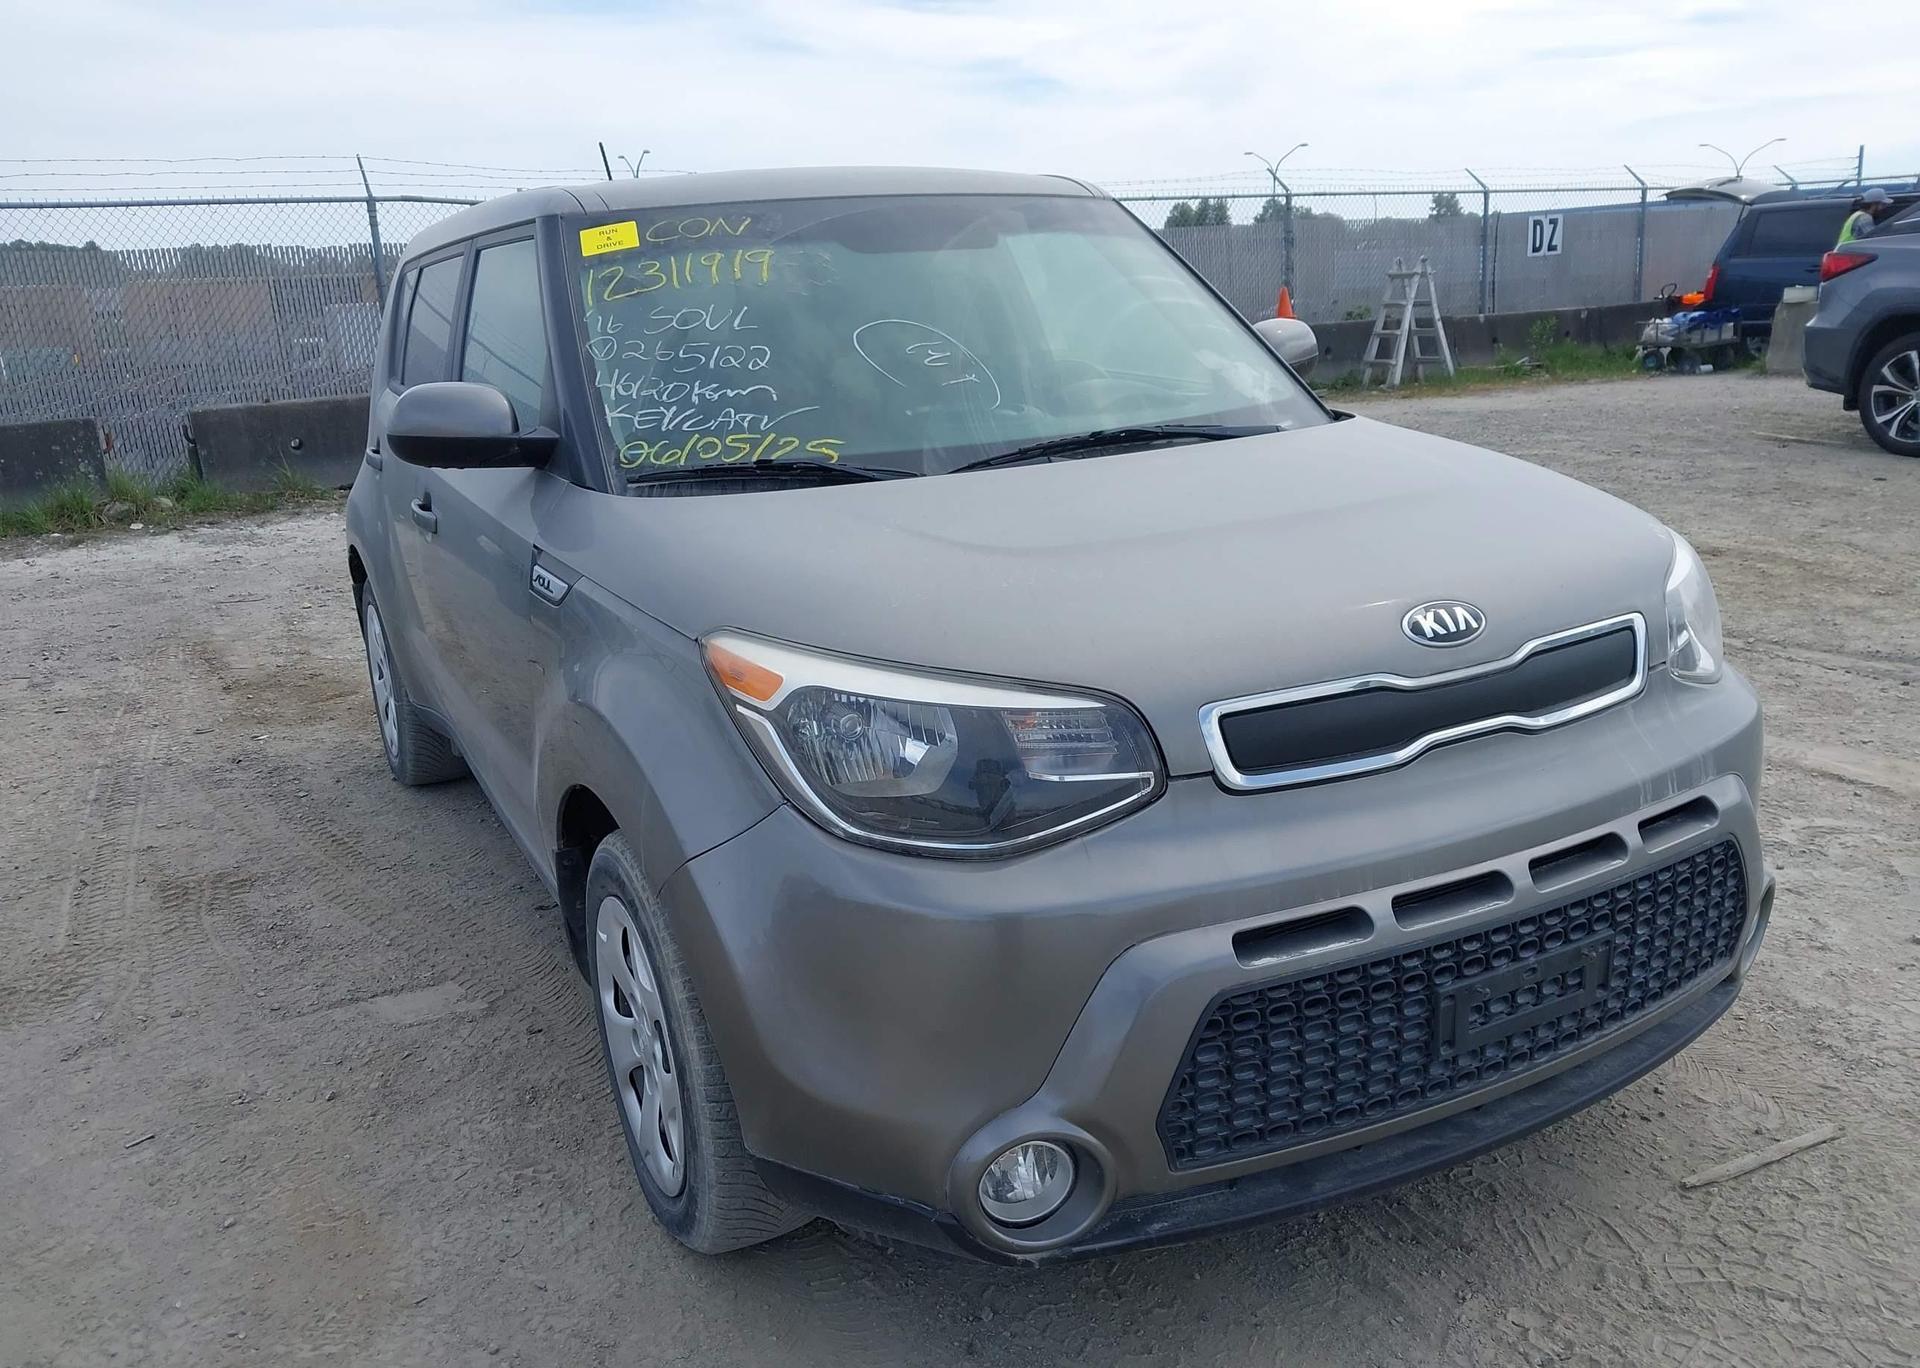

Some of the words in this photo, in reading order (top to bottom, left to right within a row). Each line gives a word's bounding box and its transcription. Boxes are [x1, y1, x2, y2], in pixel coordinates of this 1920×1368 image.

[596, 240, 624, 249] DRIVE
[598, 228, 618, 236] RUN
[645, 217, 751, 242] CON
[1531, 217, 1559, 253] DZ
[587, 249, 774, 306] 12311919
[644, 303, 759, 335] SOUL
[1413, 606, 1479, 638] KIA
